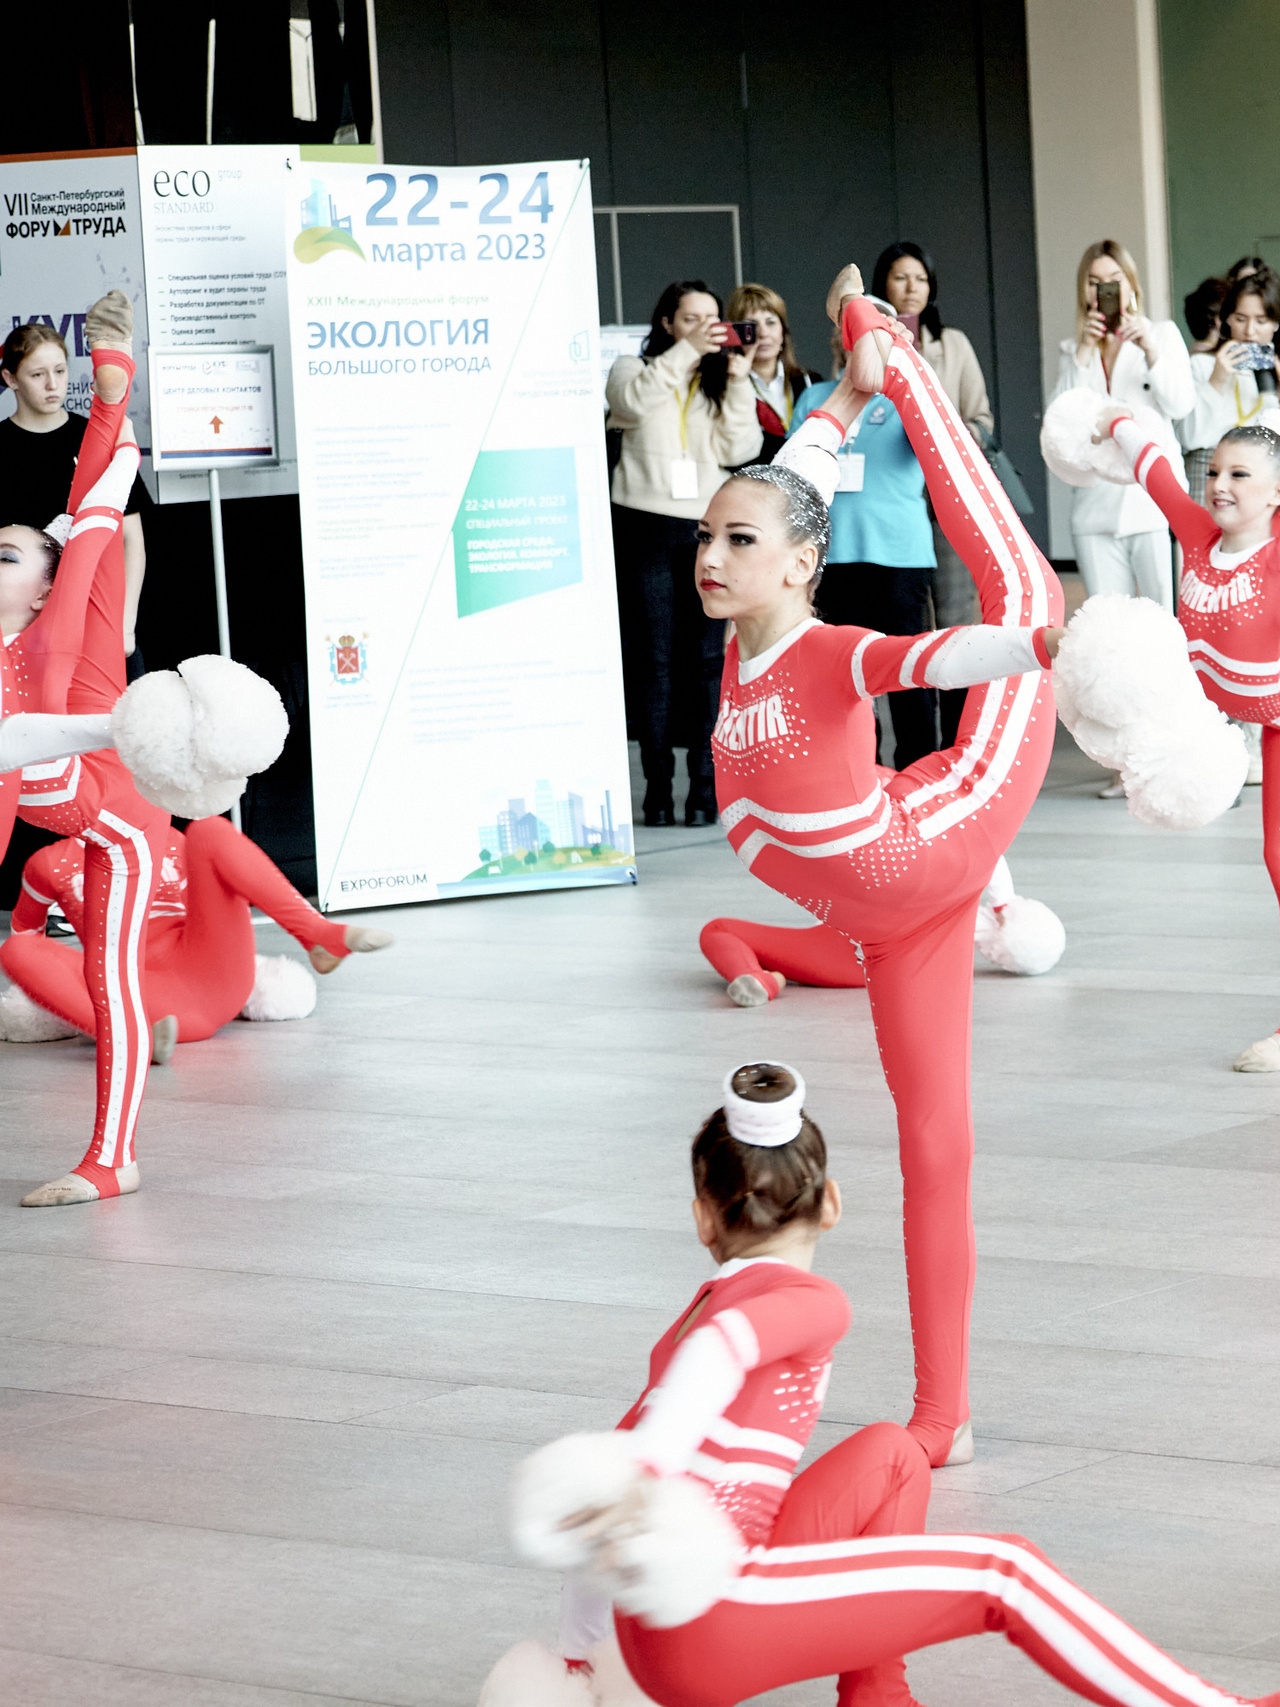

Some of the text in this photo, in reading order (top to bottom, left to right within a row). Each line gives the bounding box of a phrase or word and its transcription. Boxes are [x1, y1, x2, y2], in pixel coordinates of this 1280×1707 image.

[153, 170, 211, 197] eco
[4, 193, 29, 216] VII
[30, 189, 125, 202] Санкт-Петербургский
[365, 171, 554, 227] 22-24
[31, 198, 126, 216] Международный
[153, 202, 215, 214] STANDARD
[72, 216, 127, 237] ТРУДА
[371, 233, 546, 271] марта 2023
[307, 294, 489, 309] XXII Международный форум
[307, 318, 489, 350] ЭКОЛОГИЯ
[308, 356, 491, 376] БОЛЬШОГО ГОРОДА
[163, 387, 185, 395] ЦЕНТР
[222, 385, 262, 394] КОНТАКТОВ
[465, 498, 495, 511] 22-24
[497, 496, 536, 509] МАРТА
[538, 495, 566, 508] 2023
[466, 514, 568, 529] СПЕЦИАЛЬНЫЙ ПРОЕКТ
[341, 873, 428, 893] EXPOFORUM
